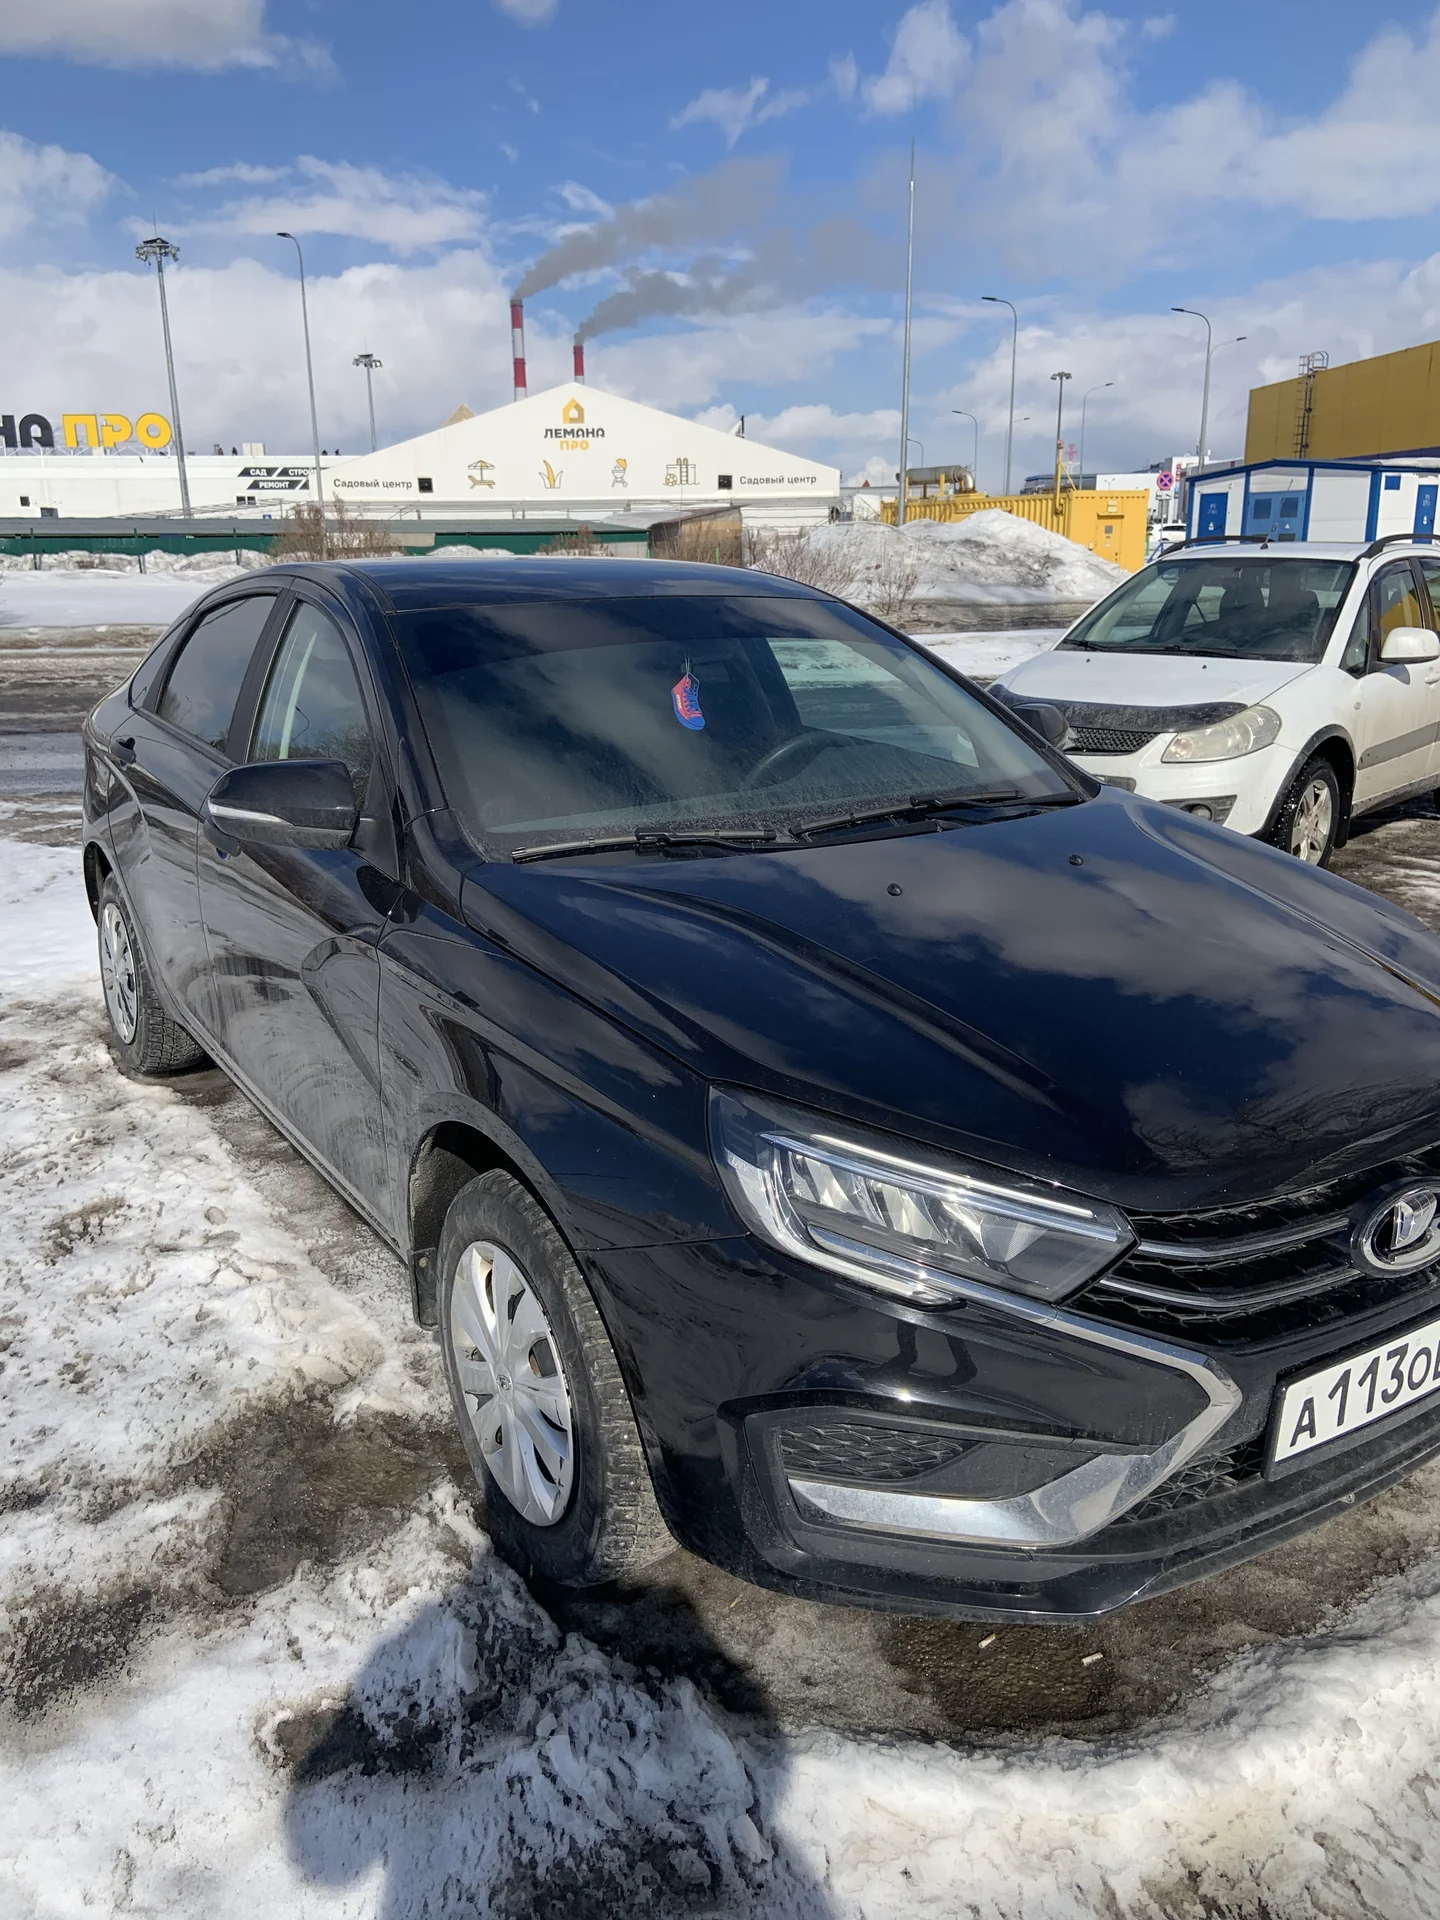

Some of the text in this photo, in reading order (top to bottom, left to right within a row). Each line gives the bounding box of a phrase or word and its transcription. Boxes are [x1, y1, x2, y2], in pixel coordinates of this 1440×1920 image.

[62, 413, 172, 449] ПРО
[543, 427, 606, 439] ЛЕМАНА
[559, 440, 590, 451] ПРО
[250, 468, 268, 477] САД
[258, 481, 290, 489] РЕМОНТ
[333, 478, 413, 491] Садовый центр
[739, 475, 817, 486] Садовый центр
